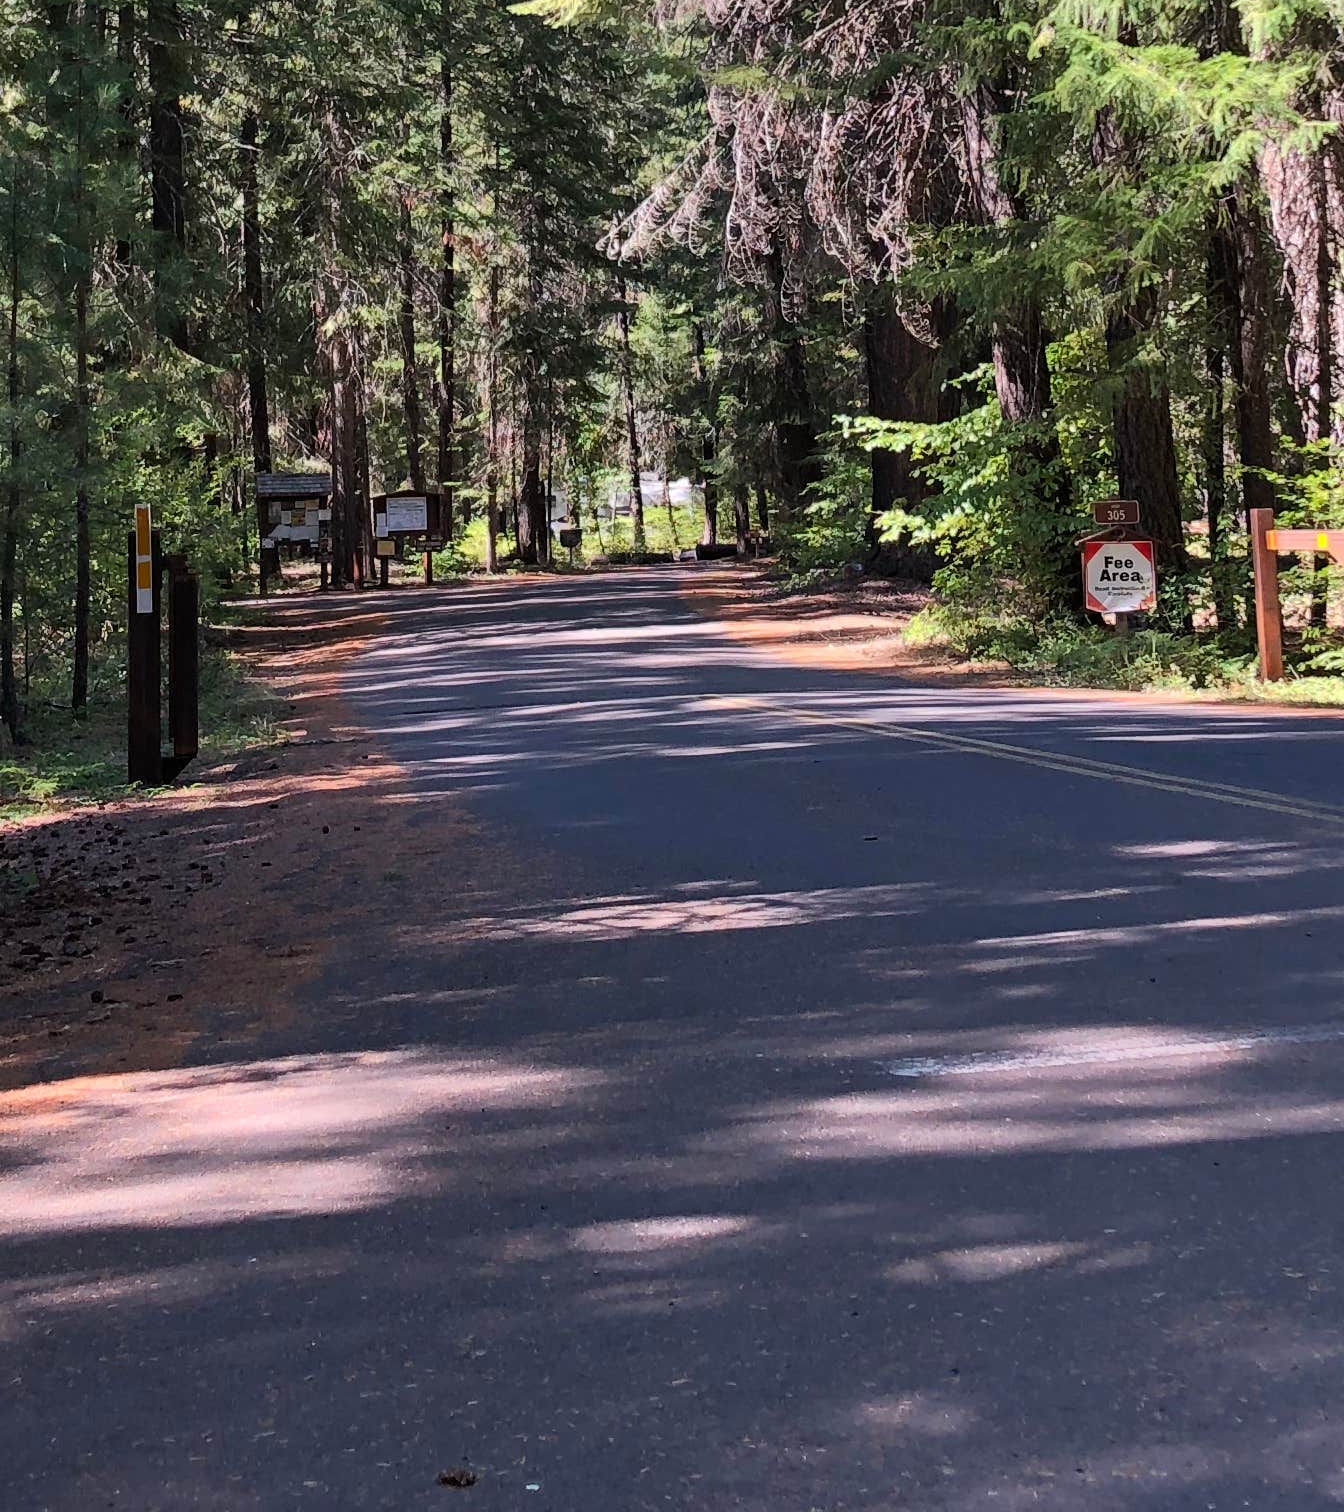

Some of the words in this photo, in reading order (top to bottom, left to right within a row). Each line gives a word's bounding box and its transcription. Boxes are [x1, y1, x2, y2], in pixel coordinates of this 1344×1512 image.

[1107, 510, 1126, 521] 305
[1104, 556, 1134, 569] Fee
[1099, 569, 1141, 582] Area
